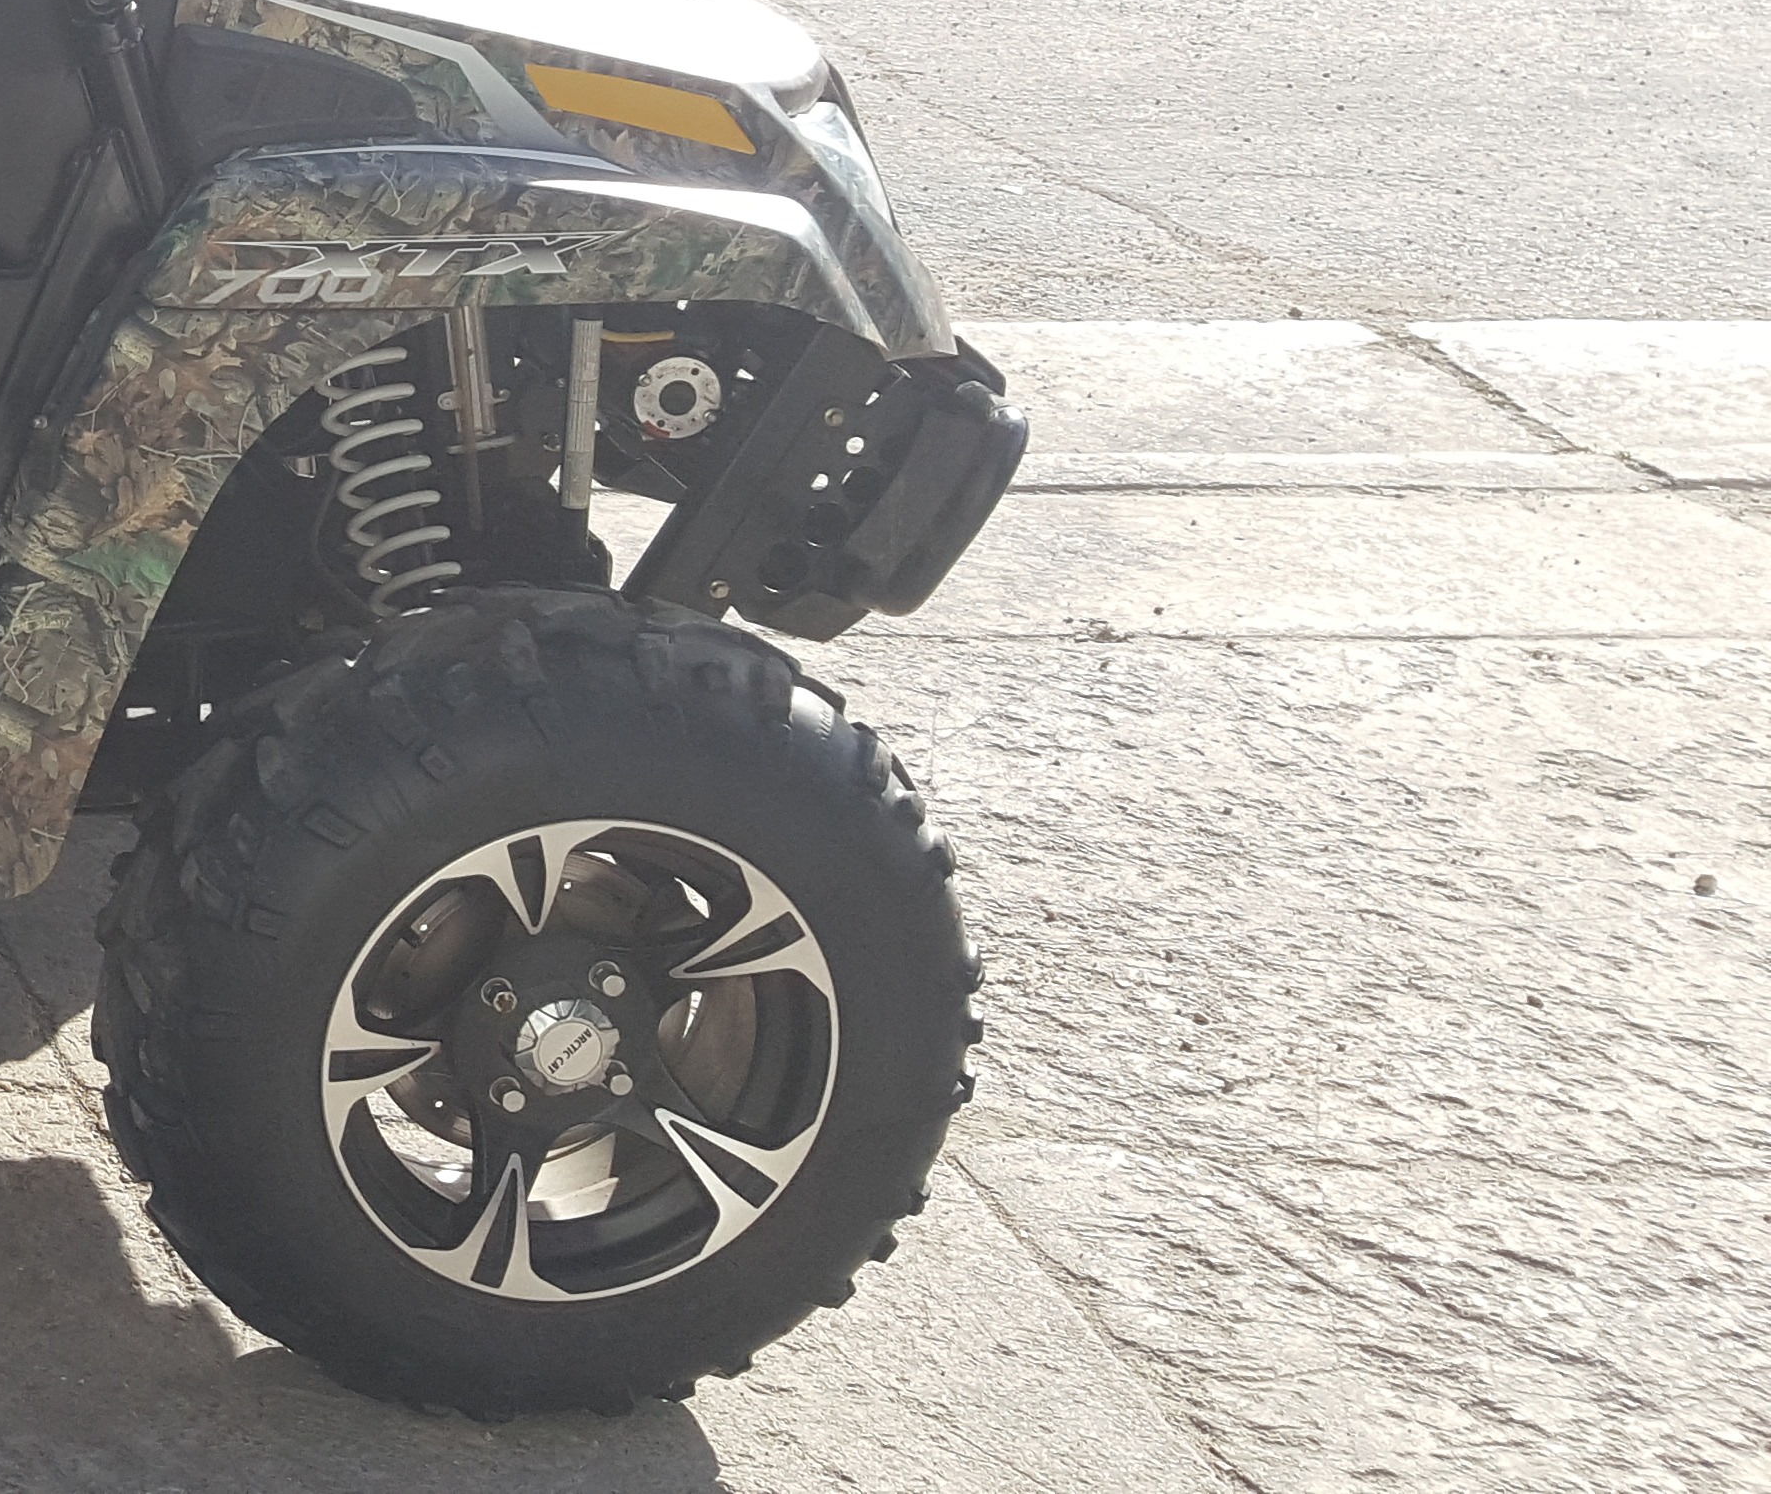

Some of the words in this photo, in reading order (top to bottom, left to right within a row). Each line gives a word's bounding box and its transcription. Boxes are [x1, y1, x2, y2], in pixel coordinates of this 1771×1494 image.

[227, 233, 609, 277] XTX
[199, 269, 385, 304] 700
[562, 1027, 592, 1060] ARCTIC
[547, 1056, 564, 1075] CAT
